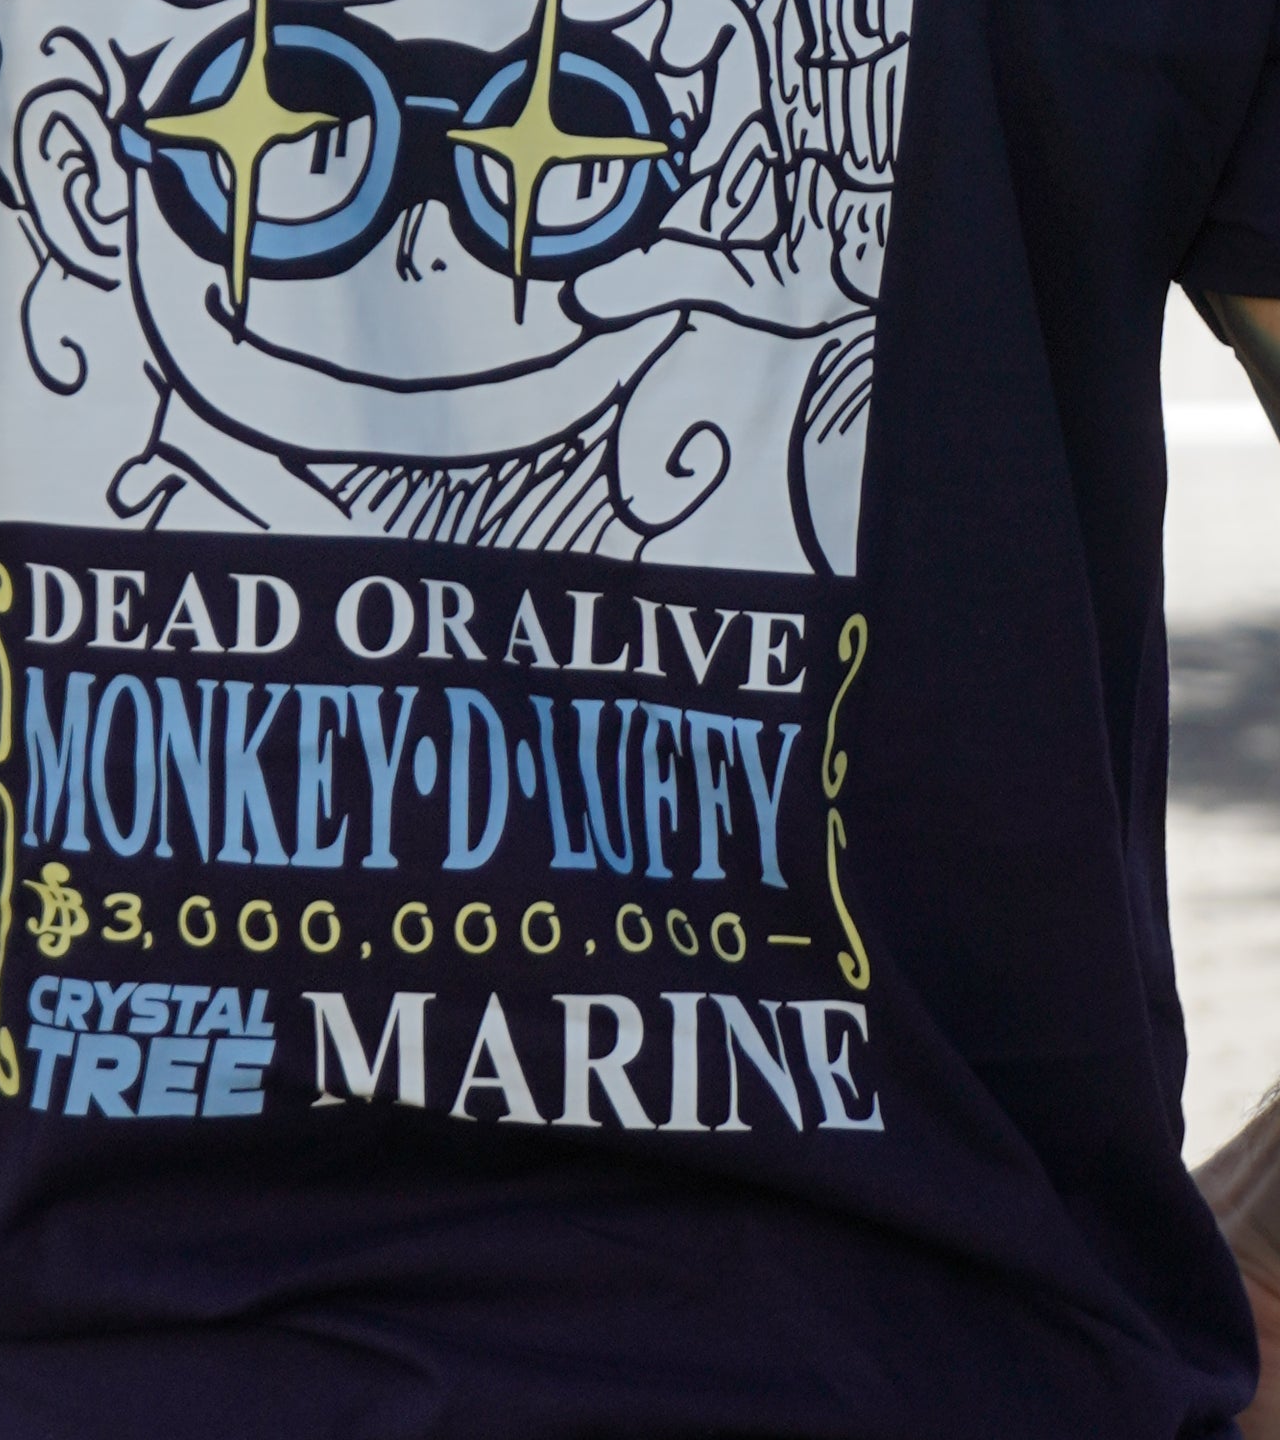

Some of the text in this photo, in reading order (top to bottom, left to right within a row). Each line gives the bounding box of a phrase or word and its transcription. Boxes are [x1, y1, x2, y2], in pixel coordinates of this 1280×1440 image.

[25, 562, 808, 694] DEAD OR ALIVE
[28, 974, 276, 1038] CRYSTAL
[300, 991, 886, 1132] MARINE
[26, 1023, 277, 1119] TREE
